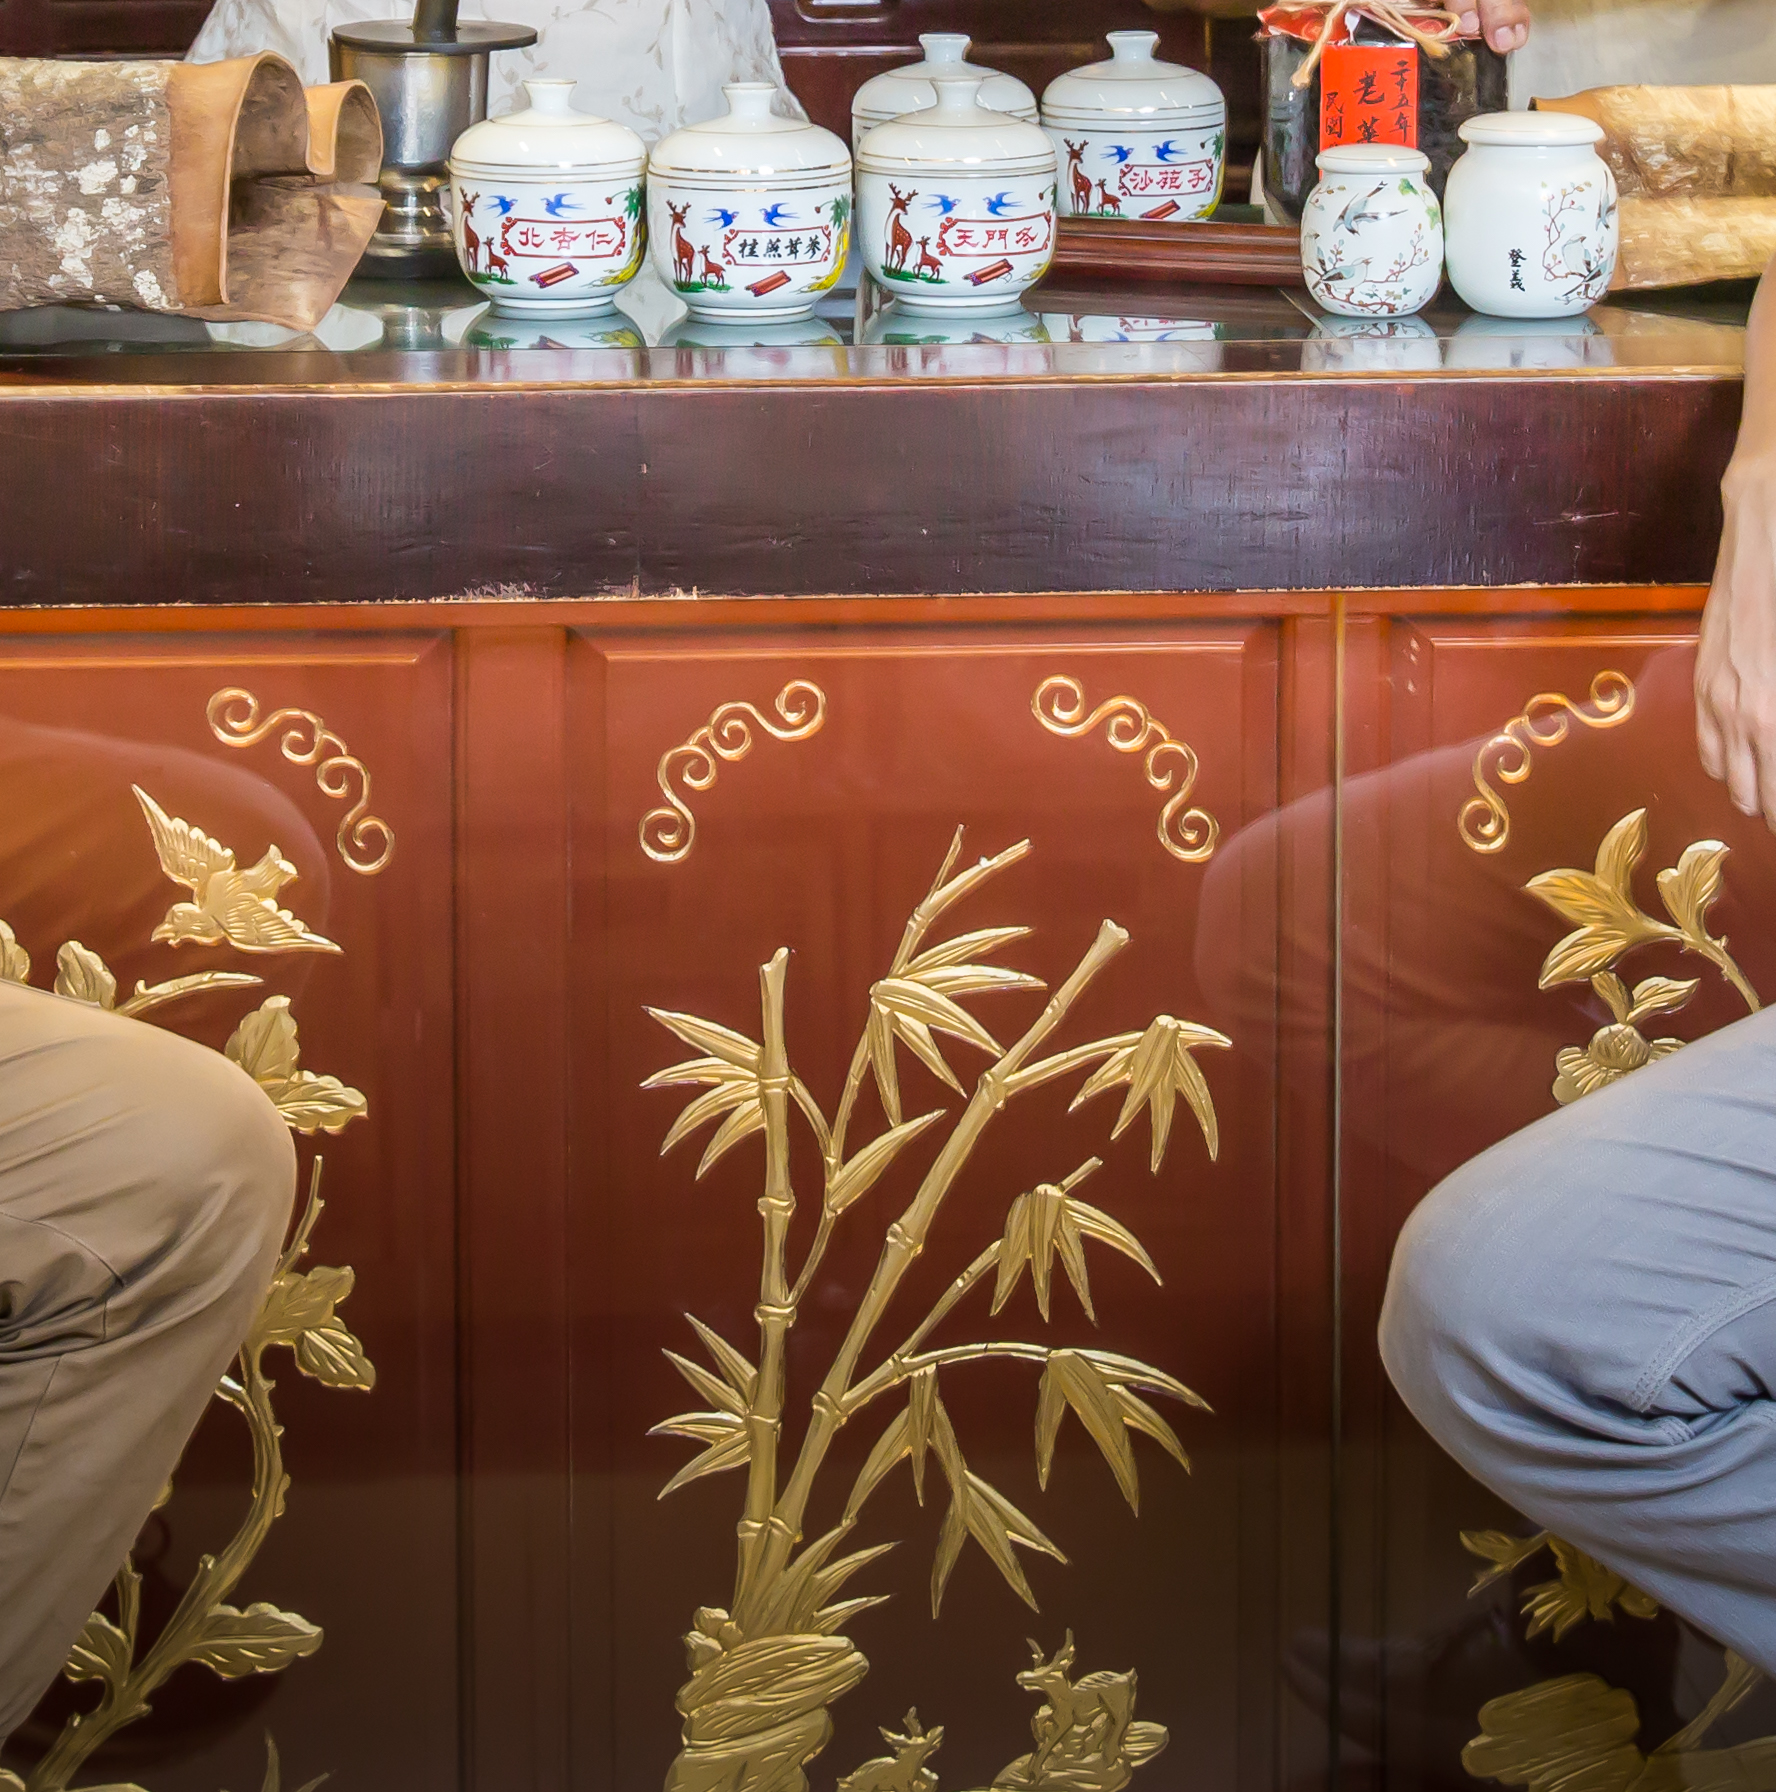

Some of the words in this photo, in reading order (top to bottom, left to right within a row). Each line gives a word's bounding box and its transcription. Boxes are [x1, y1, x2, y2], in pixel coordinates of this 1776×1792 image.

[1324, 90, 1345, 149] 民國
[1128, 167, 1209, 192] 沙苑子
[517, 226, 615, 252] 北杏仁
[953, 225, 1039, 252] 天門冬
[1507, 247, 1527, 293] 登義
